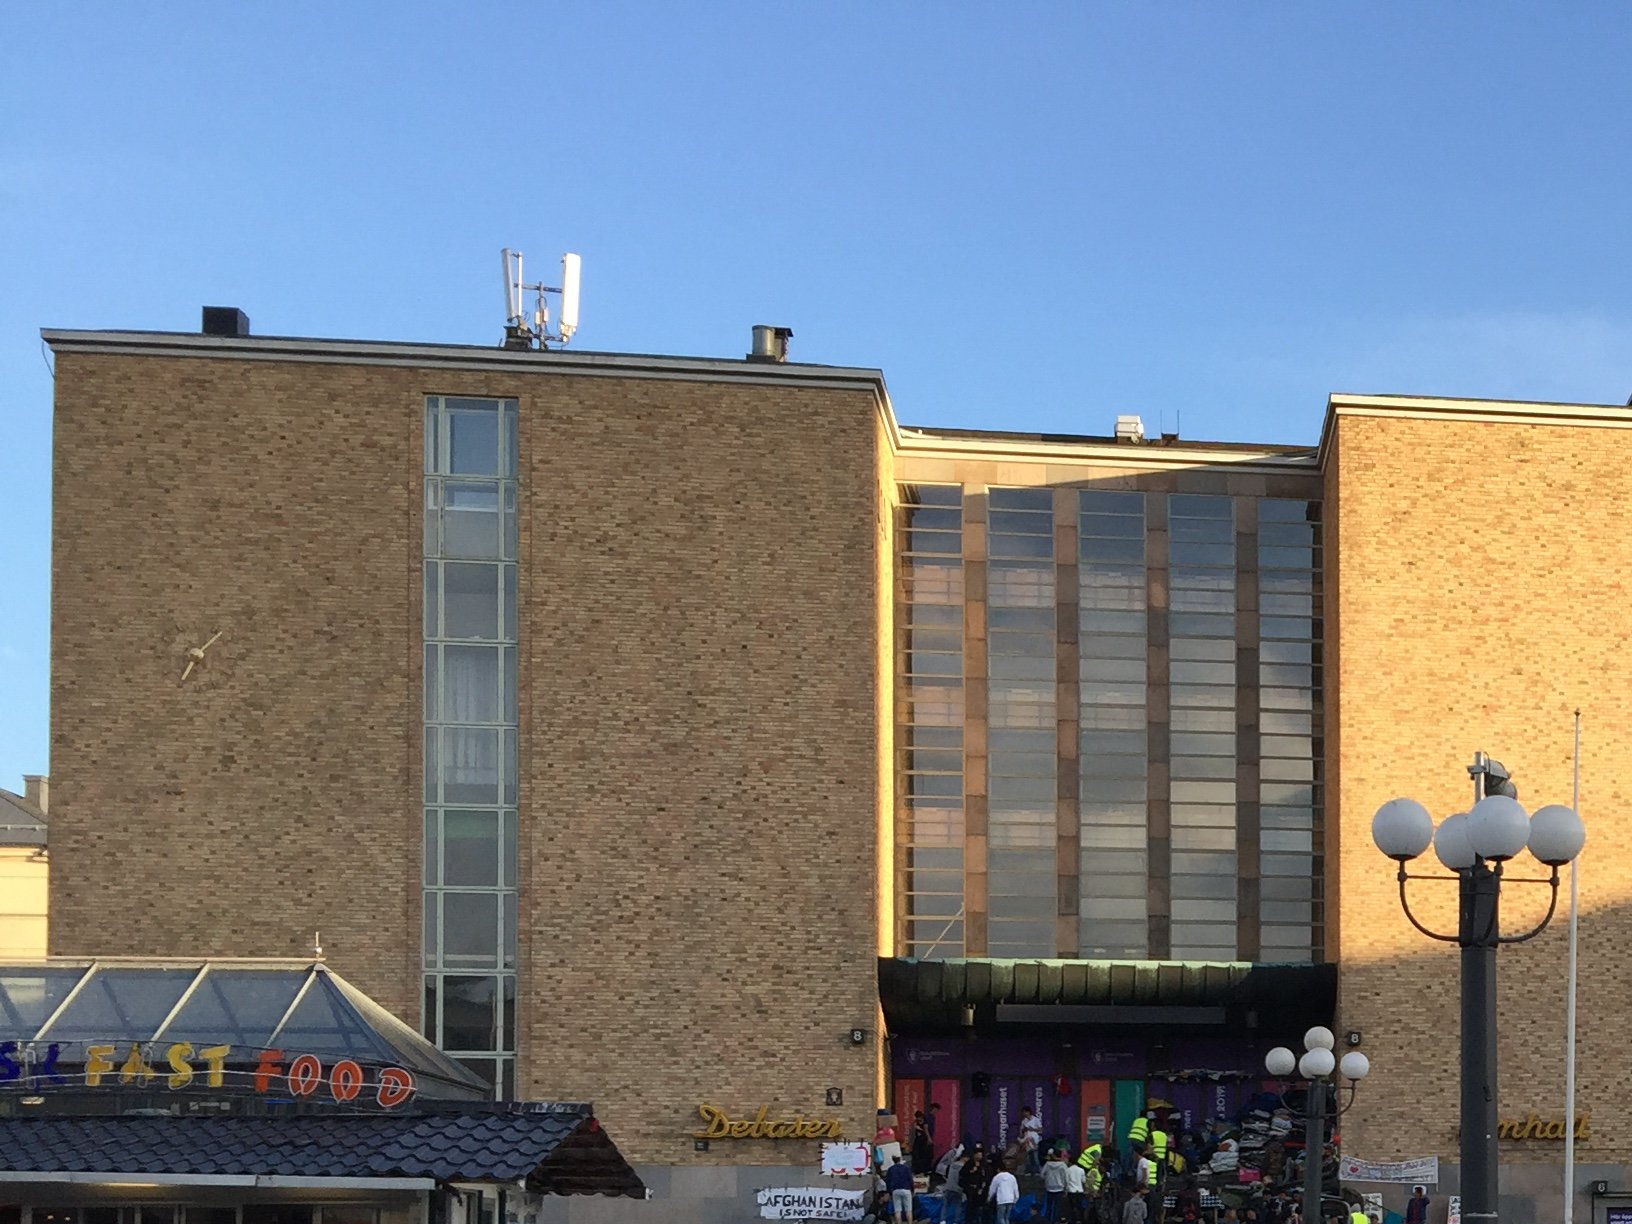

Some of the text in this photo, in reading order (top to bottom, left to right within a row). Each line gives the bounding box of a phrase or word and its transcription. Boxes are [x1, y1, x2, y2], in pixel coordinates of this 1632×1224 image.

[84, 1041, 231, 1090] FAST
[254, 1049, 417, 1108] FOOD
[692, 1104, 842, 1139] Debaser
[1598, 1182, 1605, 1191] 6
[765, 1194, 861, 1210] AFGHANISTAN
[779, 1209, 791, 1217] IS
[793, 1209, 813, 1217] NOT
